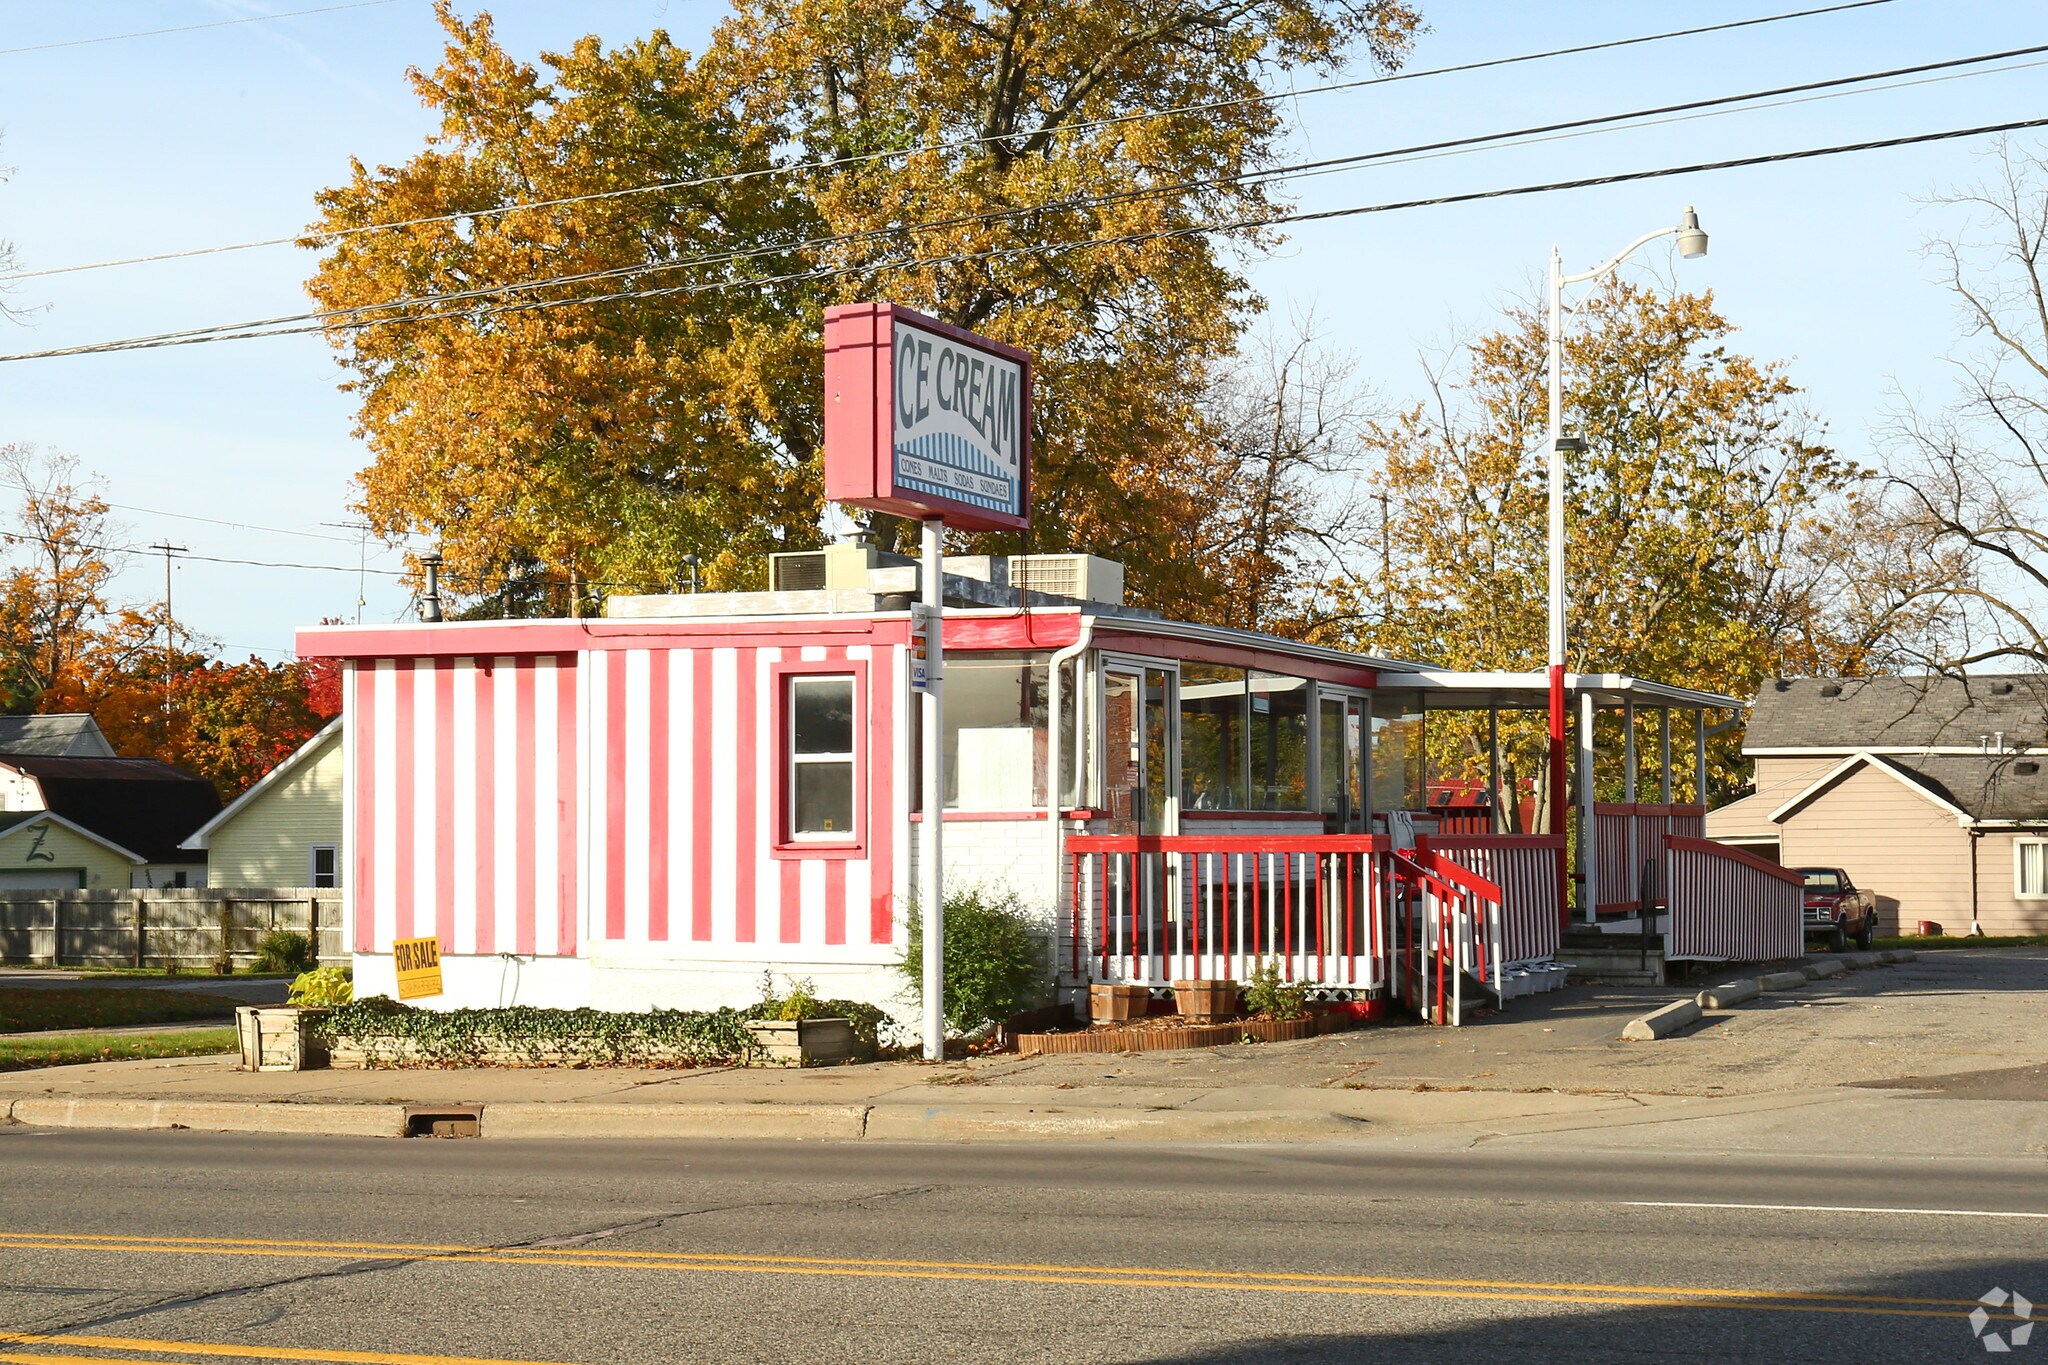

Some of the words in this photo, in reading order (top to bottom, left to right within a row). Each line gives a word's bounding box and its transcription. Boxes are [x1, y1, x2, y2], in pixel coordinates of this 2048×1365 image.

[936, 346, 1016, 466] CREAM
[900, 458, 922, 476] CONES
[928, 465, 948, 483] MALTS
[953, 472, 974, 490] SODAS
[980, 479, 1008, 498] SUNDAES
[914, 668, 926, 678] VISA
[395, 944, 413, 972] FOR
[413, 941, 438, 969] SALE
